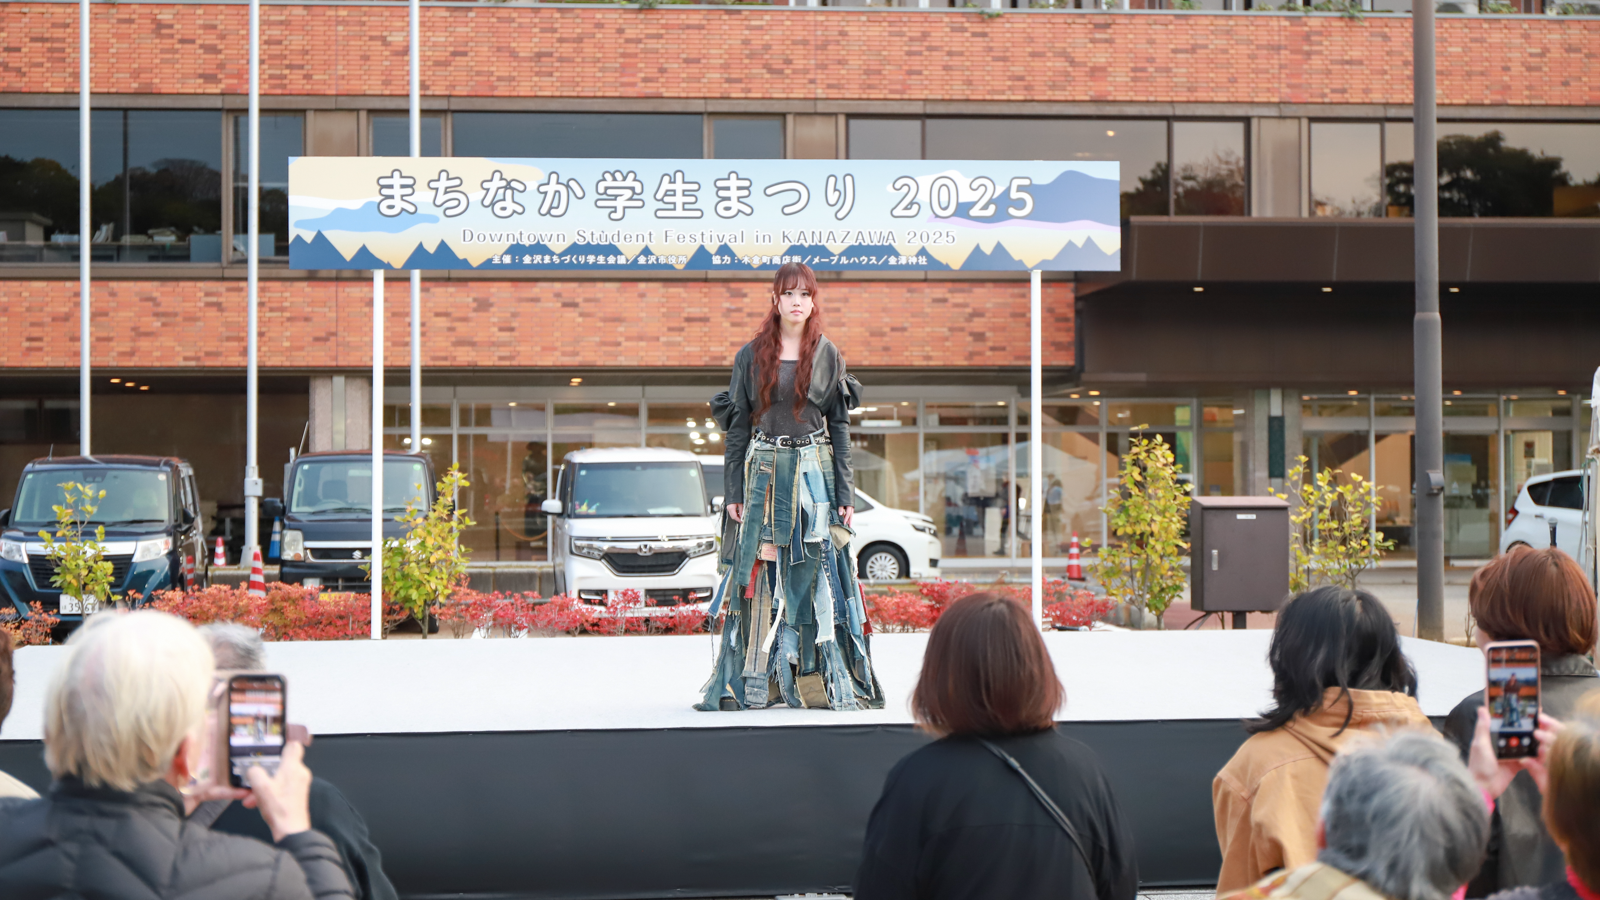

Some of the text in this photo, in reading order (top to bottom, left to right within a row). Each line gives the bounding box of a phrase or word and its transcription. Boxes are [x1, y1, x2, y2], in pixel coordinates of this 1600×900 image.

[377, 169, 1035, 221] まちなか学生まつり 2025
[462, 228, 957, 245] Downtown Student Festival in KANAZAWA 2025
